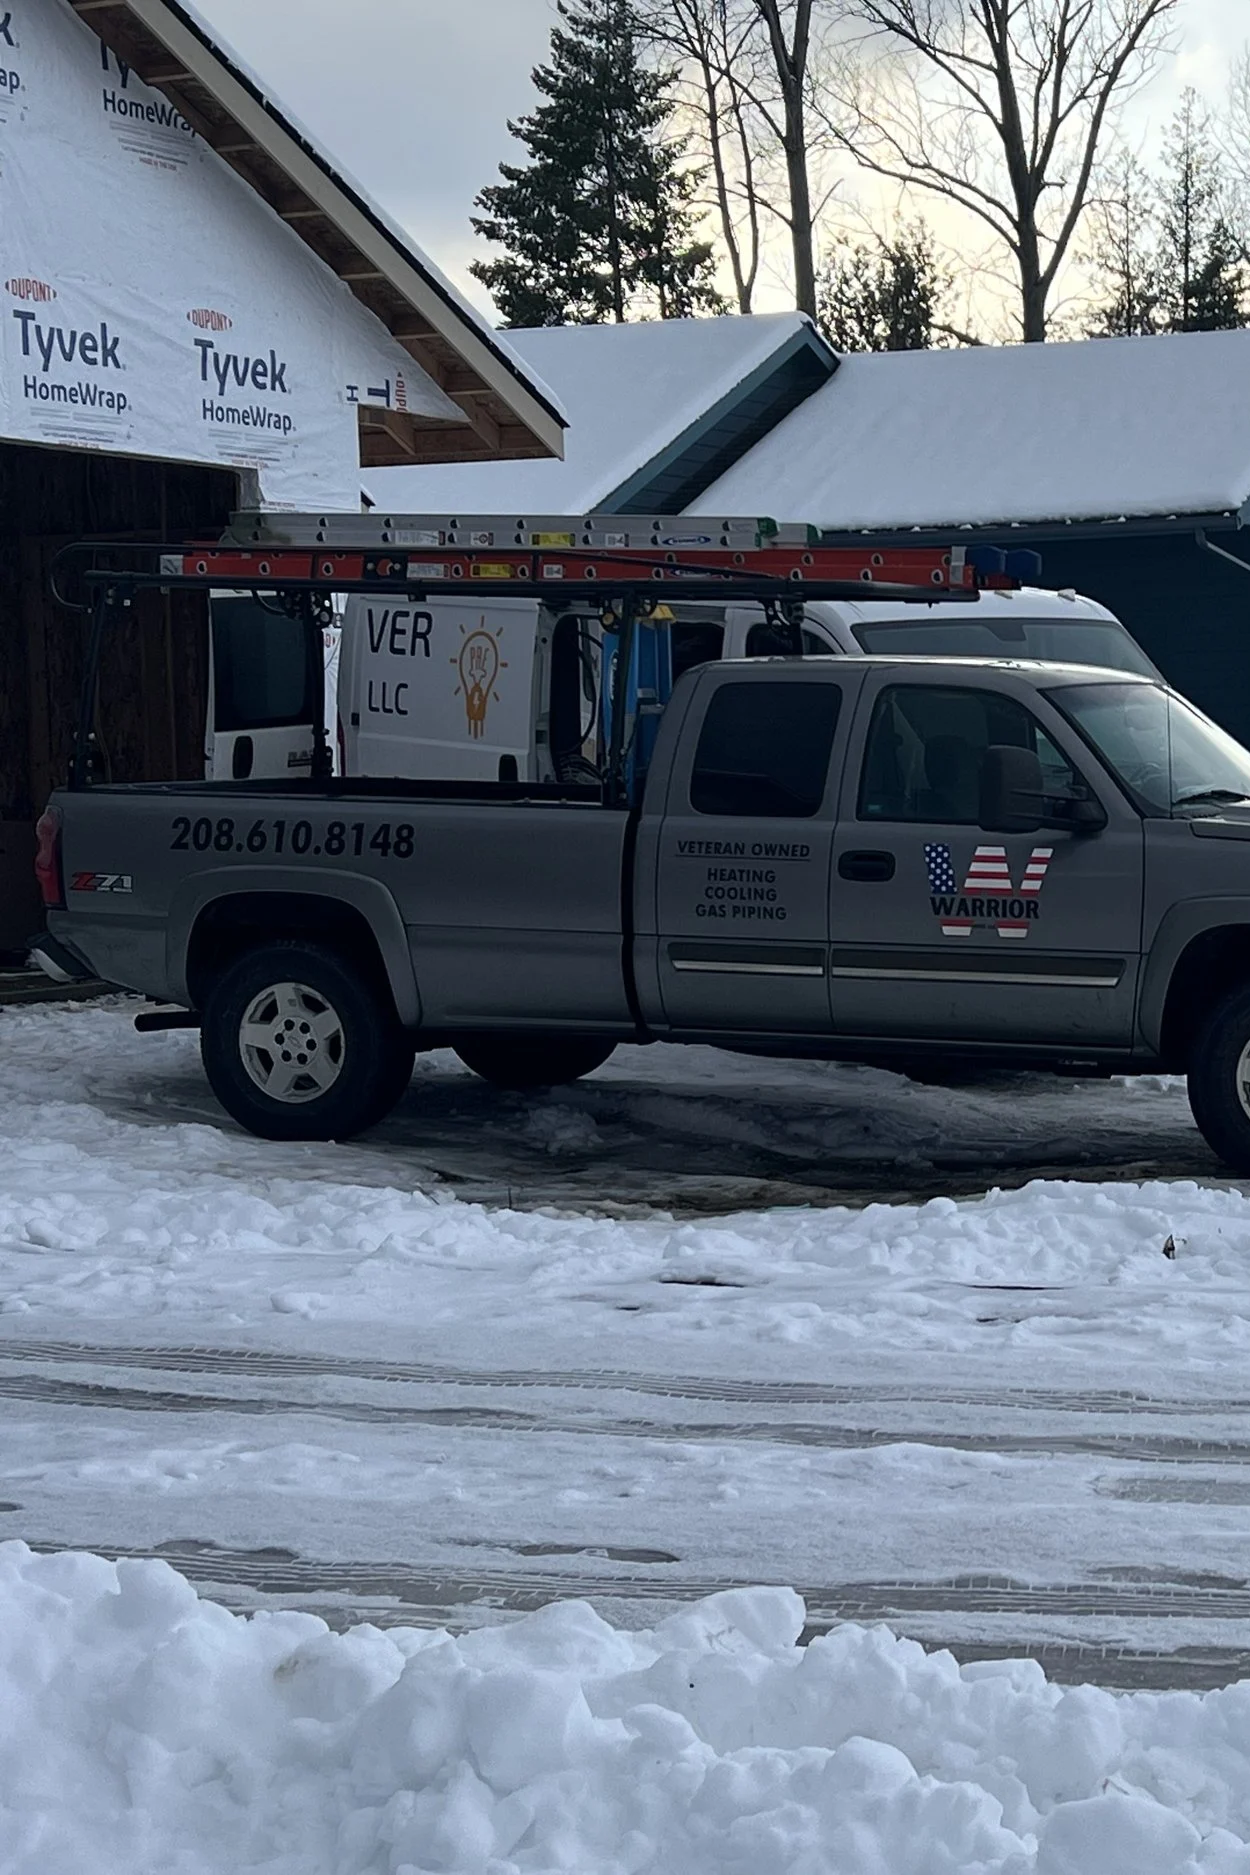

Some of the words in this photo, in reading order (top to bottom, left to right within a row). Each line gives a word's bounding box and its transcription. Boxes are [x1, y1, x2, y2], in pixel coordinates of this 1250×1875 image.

[11, 278, 52, 302] DUPONT
[192, 308, 228, 332] DUPONT
[13, 309, 123, 372] Tyvek
[193, 338, 288, 396] Tyvek
[23, 376, 128, 414] HomeWrap
[202, 399, 292, 436] HomeWrap
[368, 609, 433, 658] VER
[368, 680, 409, 716] LLC
[170, 816, 415, 859] 208.610.8148
[677, 840, 745, 855] VETERAN
[751, 843, 811, 857] OWNED
[70, 872, 133, 892] Z71
[707, 867, 776, 883] HEATING
[704, 886, 777, 902] COOLING
[695, 903, 727, 918] GAS
[732, 905, 787, 920] PIPING
[930, 896, 1039, 919] WARRIOR
